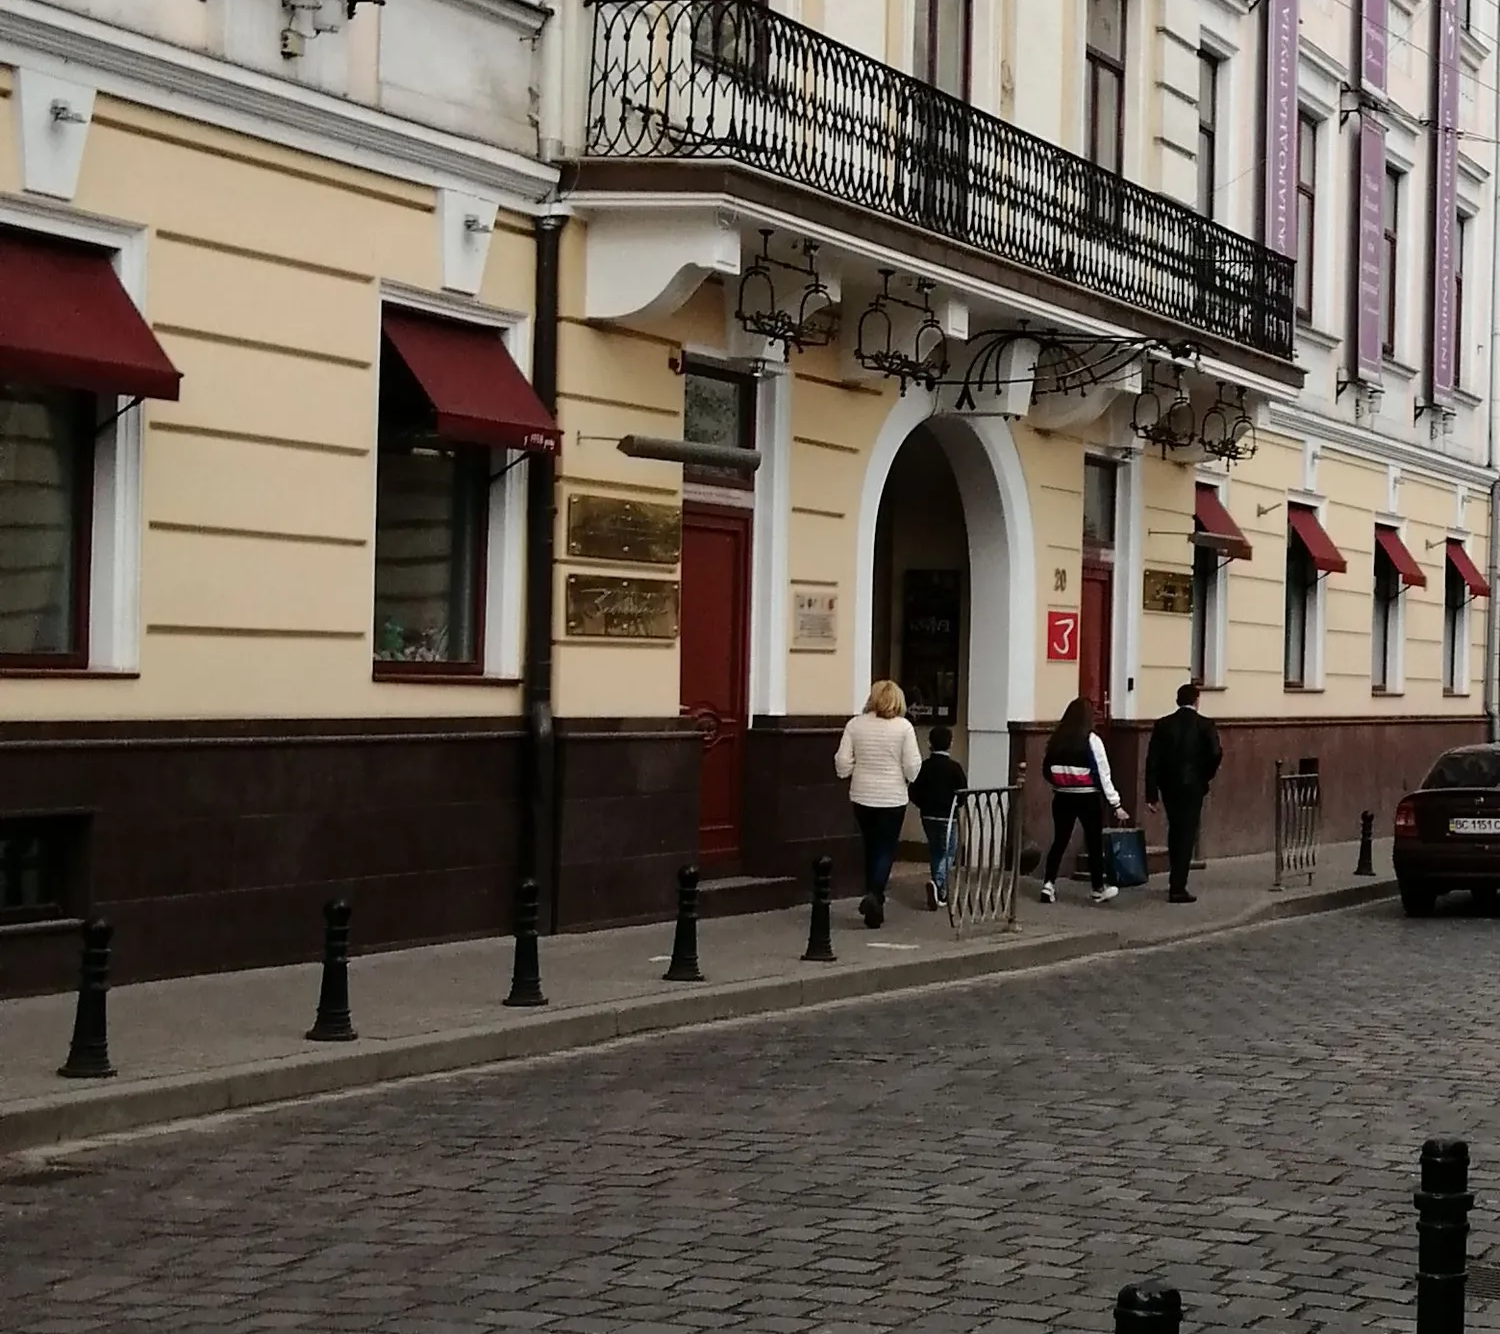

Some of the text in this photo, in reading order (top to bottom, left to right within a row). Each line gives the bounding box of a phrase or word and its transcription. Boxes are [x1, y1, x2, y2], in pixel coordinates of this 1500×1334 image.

[1441, 191, 1452, 370] INTERNATIONAL
[1053, 568, 1067, 591] 20
[1455, 819, 1469, 830] BC
[1471, 819, 1492, 830] 1151
